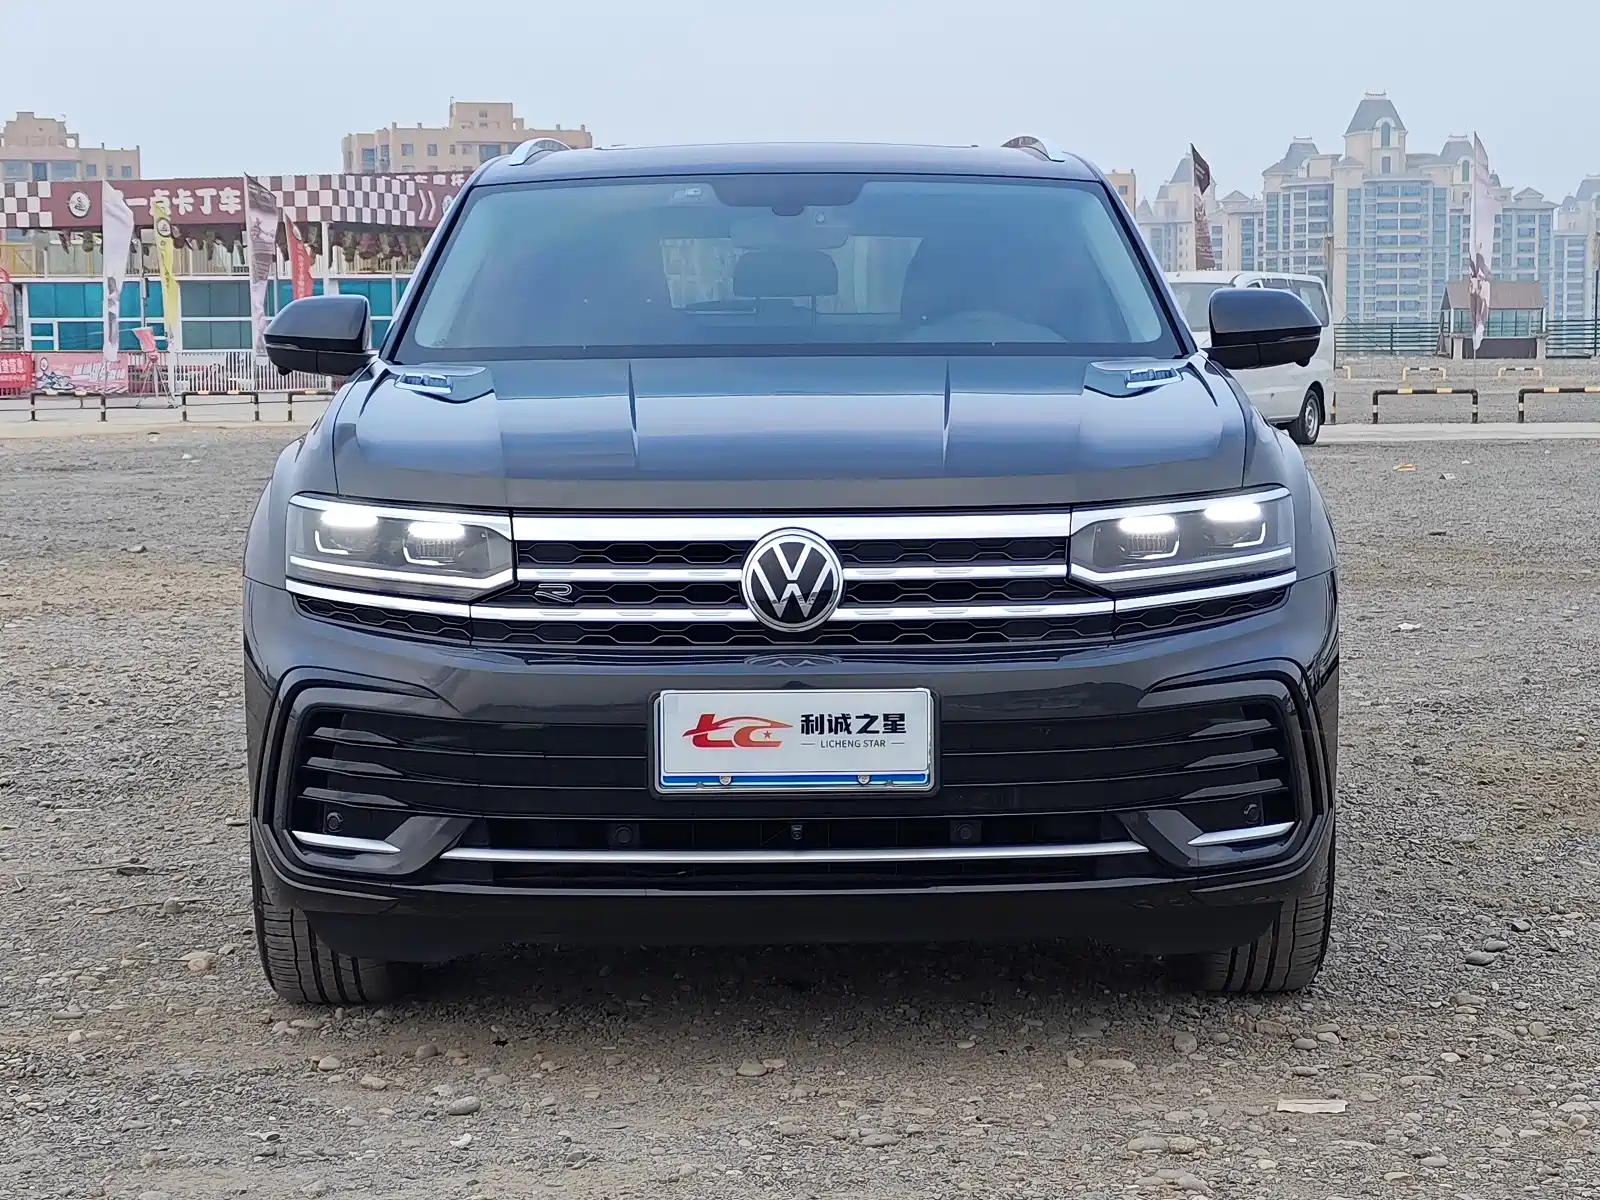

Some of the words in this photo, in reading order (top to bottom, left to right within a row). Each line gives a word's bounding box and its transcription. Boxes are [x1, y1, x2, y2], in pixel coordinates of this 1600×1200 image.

[118, 188, 242, 216] 一点卡丁车
[800, 712, 907, 735] 利诚之星
[820, 739, 861, 748] LICHENG
[863, 739, 886, 748] STAR
